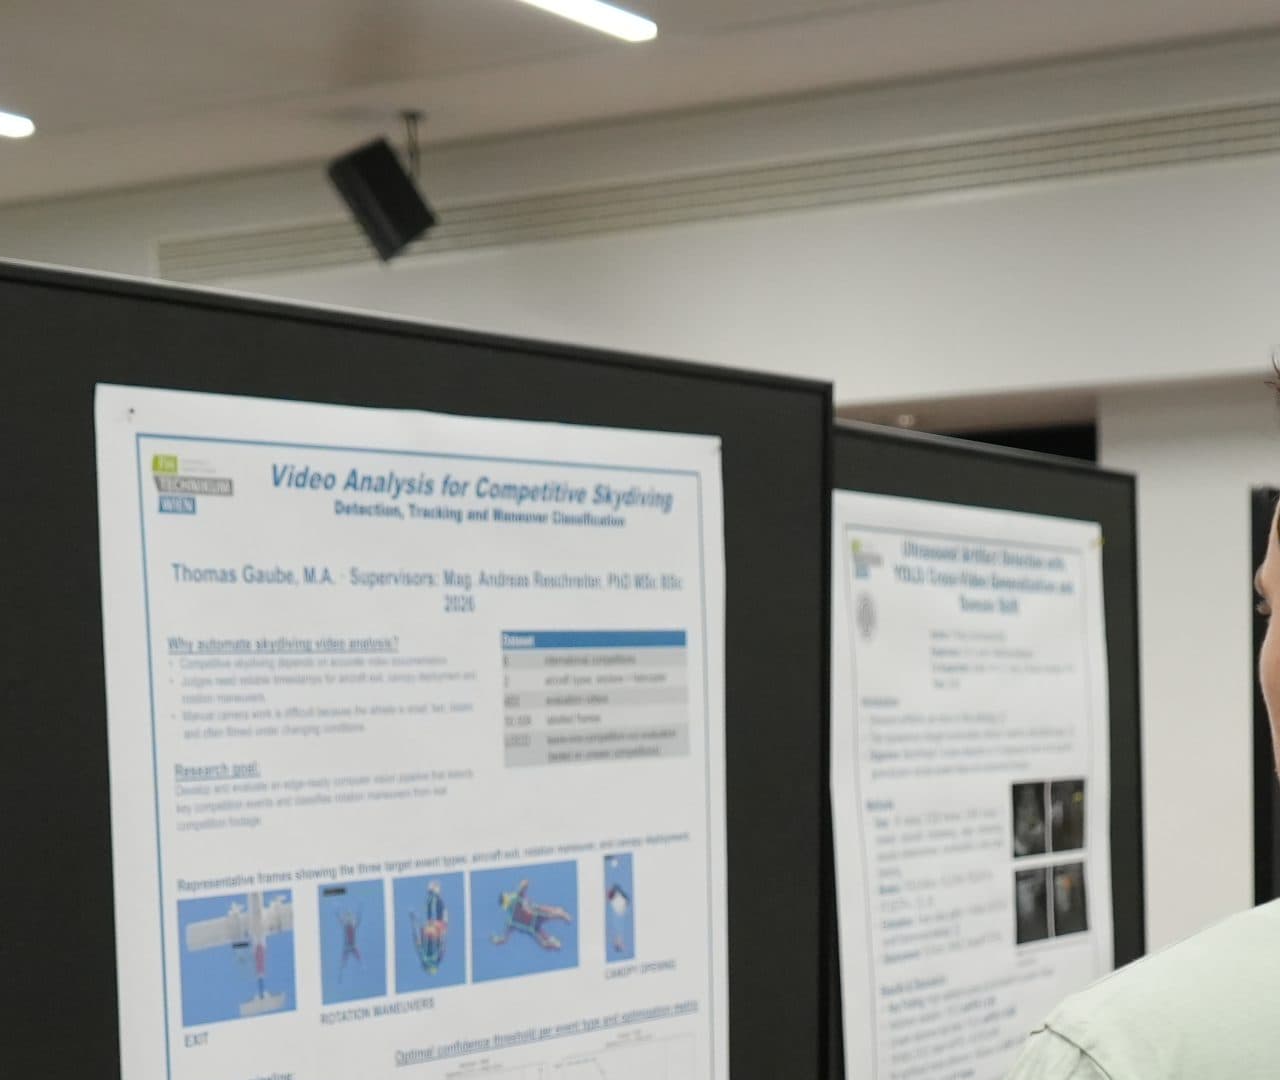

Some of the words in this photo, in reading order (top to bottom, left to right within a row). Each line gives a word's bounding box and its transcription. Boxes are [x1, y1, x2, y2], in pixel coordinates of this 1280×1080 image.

[271, 463, 336, 490] Video
[343, 469, 435, 499] Analysis
[442, 474, 470, 496] for
[476, 475, 587, 504] Competitive
[592, 483, 674, 513] Skydiving
[334, 500, 405, 520] Detection,
[409, 504, 463, 523] Tracking
[467, 508, 489, 522] and
[171, 563, 237, 583] Thomas
[242, 565, 299, 587] Gaube,
[303, 566, 336, 584] M.A.
[349, 566, 437, 589] Supervisors:
[478, 570, 530, 589] Andreas
[320, 1007, 370, 1024] ROTATION
[373, 997, 434, 1016] MANEUVERS
[185, 1031, 208, 1047] EXIT
[395, 1047, 434, 1063] Optimal
[437, 1038, 489, 1056] confidence
[493, 1028, 535, 1046] threshold
